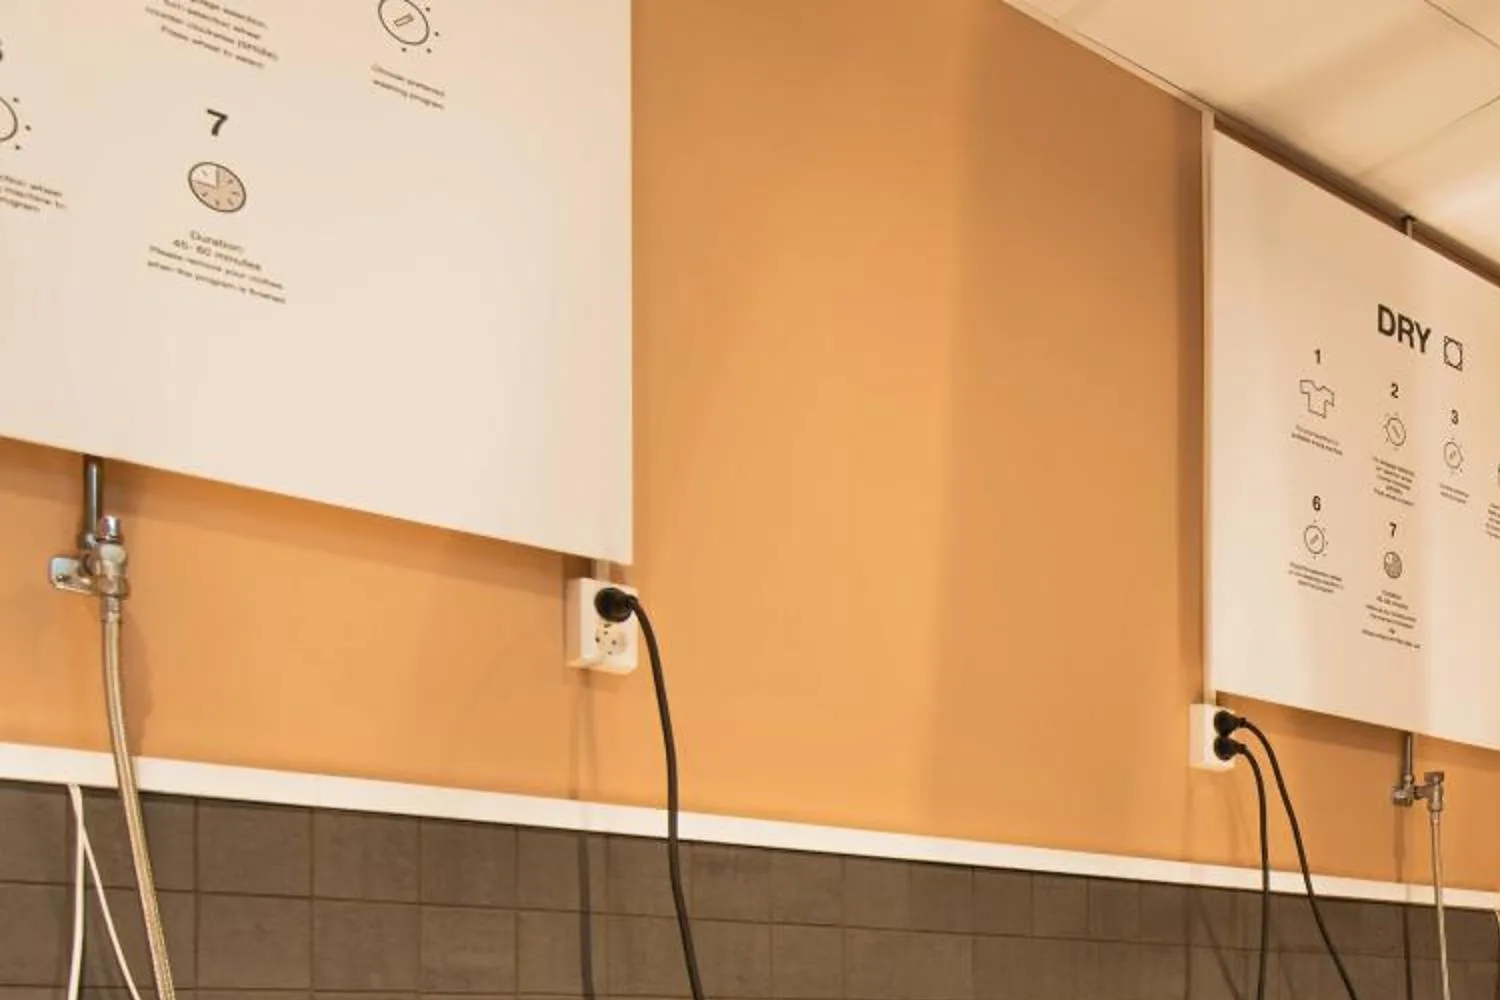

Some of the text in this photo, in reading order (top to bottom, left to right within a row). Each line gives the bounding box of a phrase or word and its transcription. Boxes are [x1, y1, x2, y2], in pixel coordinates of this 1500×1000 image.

[206, 108, 229, 137] 7
[1377, 303, 1431, 353] DRY
[1313, 349, 1321, 364] 1
[1390, 382, 1399, 399] 2
[1451, 409, 1459, 425] 3
[1312, 495, 1321, 511] 6
[1389, 521, 1397, 538] 7
